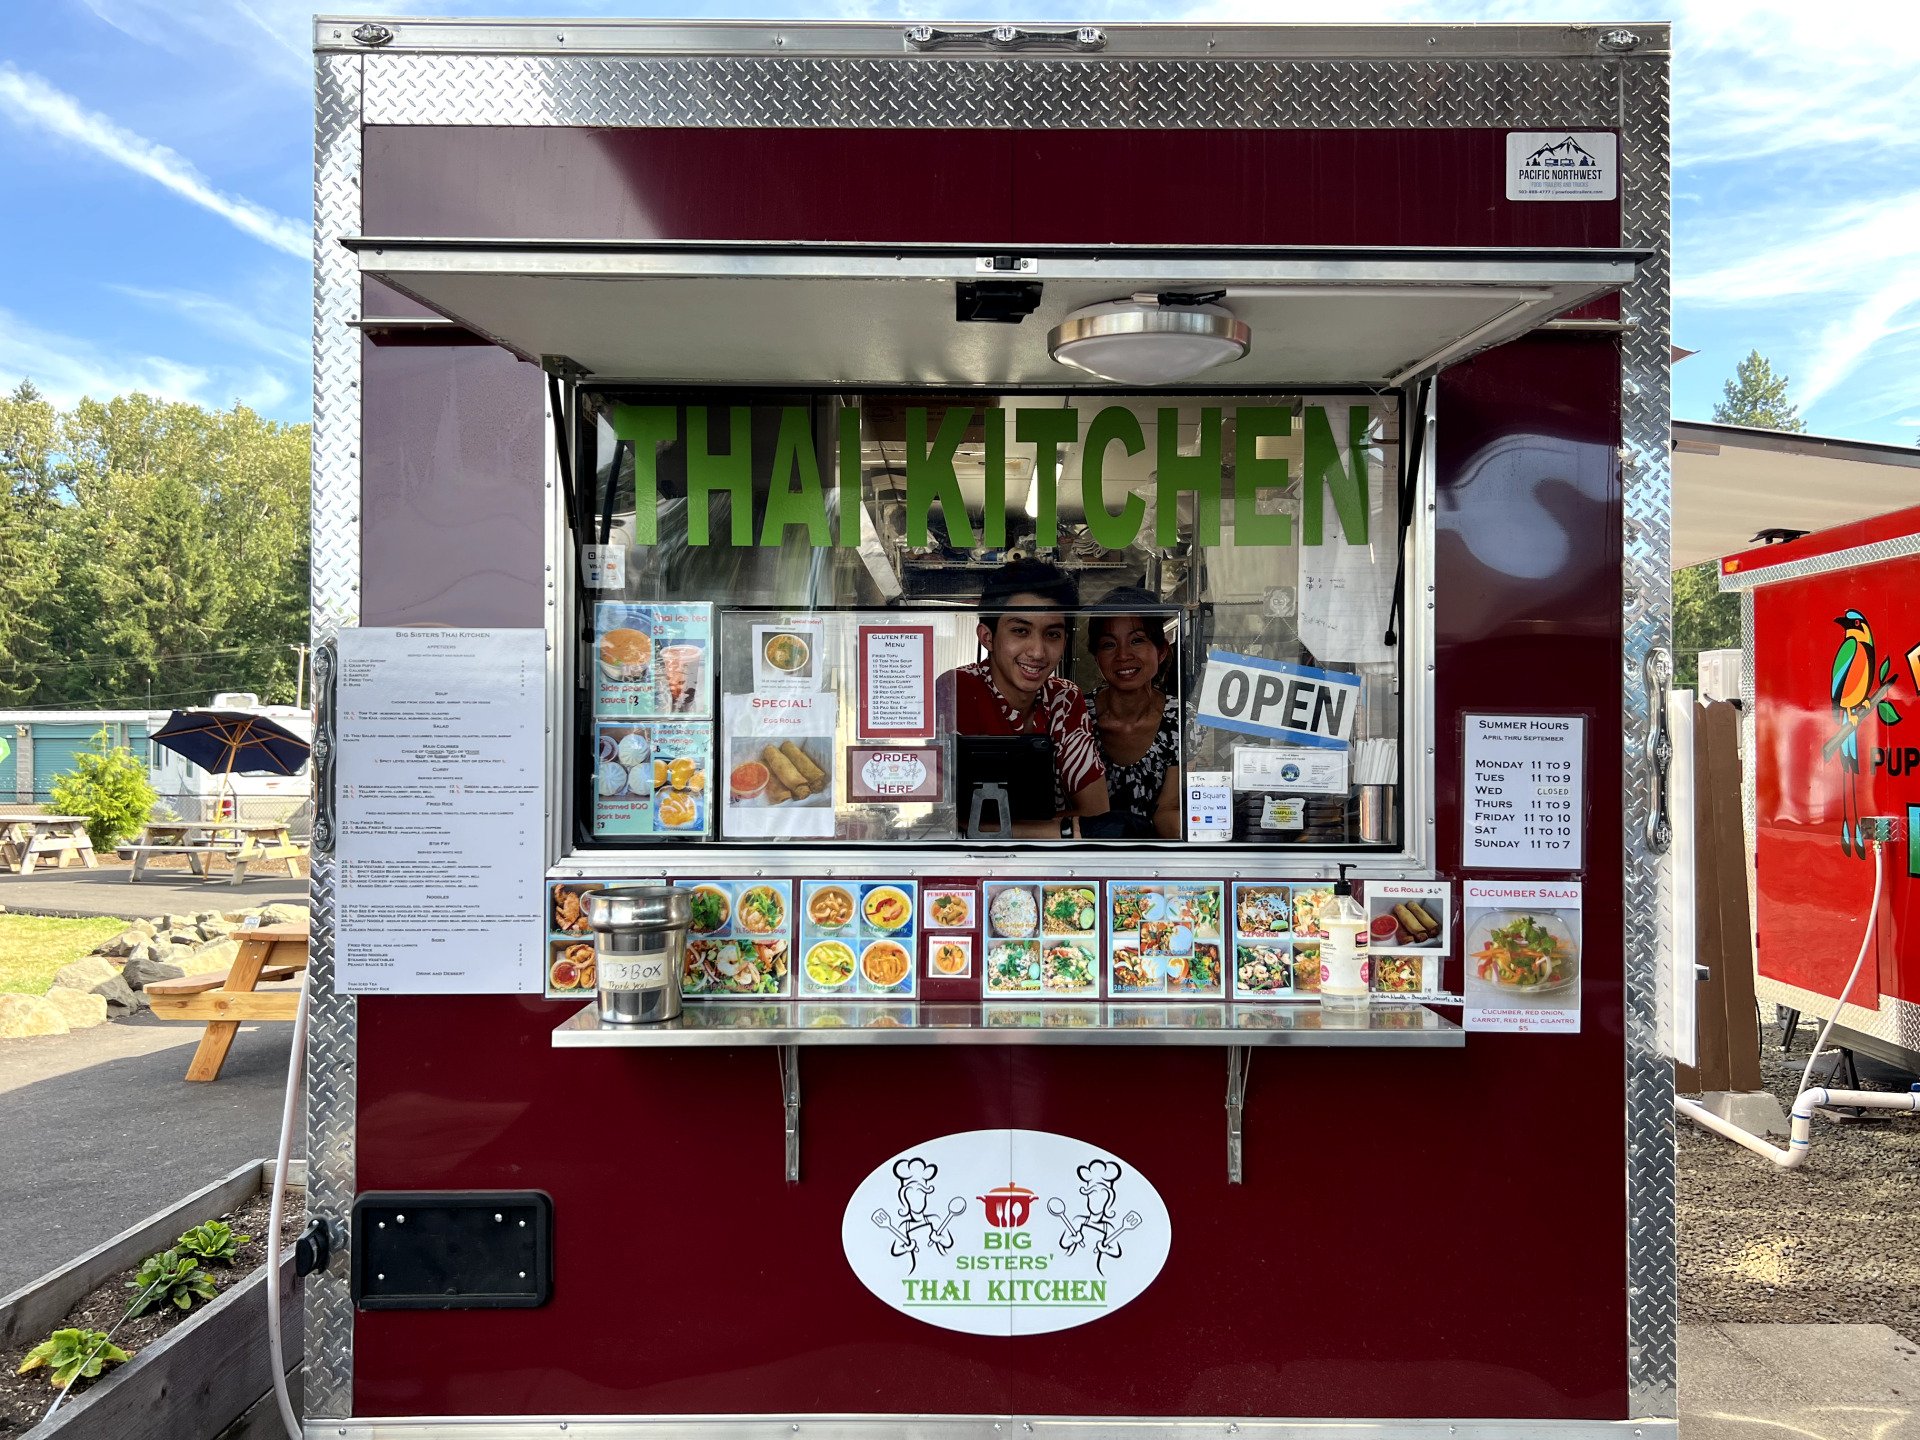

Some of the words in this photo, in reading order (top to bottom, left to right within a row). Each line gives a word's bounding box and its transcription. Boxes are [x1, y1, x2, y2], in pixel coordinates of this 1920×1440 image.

[1519, 170, 1550, 180] PACIFIC
[1552, 170, 1602, 180] NORTHWEST
[614, 404, 862, 547] THAI
[906, 404, 1370, 548] KITCHEN
[692, 614, 707, 622] tea
[653, 626, 664, 635] $5
[601, 684, 619, 692] Side
[752, 698, 812, 709] SPECIAL!
[1217, 669, 1347, 737] OPEN
[1479, 720, 1527, 729] SUMMER
[1530, 721, 1569, 730] HOURS
[872, 752, 918, 762] ORDER
[1475, 760, 1524, 769] MONDAY
[1531, 761, 1541, 769] 11
[1563, 761, 1571, 769] 9
[1475, 772, 1504, 781] TUES
[1531, 774, 1541, 782] 11
[1563, 774, 1571, 782] 9
[877, 784, 913, 793] HERE
[1475, 786, 1503, 794] WED
[1475, 799, 1513, 808] THURS
[1531, 801, 1541, 809] 11
[1563, 801, 1571, 809] 9
[1475, 812, 1515, 821] FRIDAY
[1524, 814, 1534, 822] 11
[1558, 814, 1571, 822] 10
[1475, 826, 1497, 834] SAT
[1524, 827, 1534, 835] 11
[1558, 827, 1571, 835] 10
[1475, 839, 1520, 848] SUNDAY
[1531, 840, 1541, 848] 11
[1563, 840, 1570, 849] 7
[1470, 888, 1535, 897] CUCUMBER
[1539, 889, 1578, 898] SALAD
[631, 963, 662, 979] BOX
[984, 1232, 1032, 1250] BIG
[956, 1254, 1054, 1270] SISTERS'
[902, 1280, 971, 1301] THAI
[988, 1280, 1107, 1302] KITCHEN
